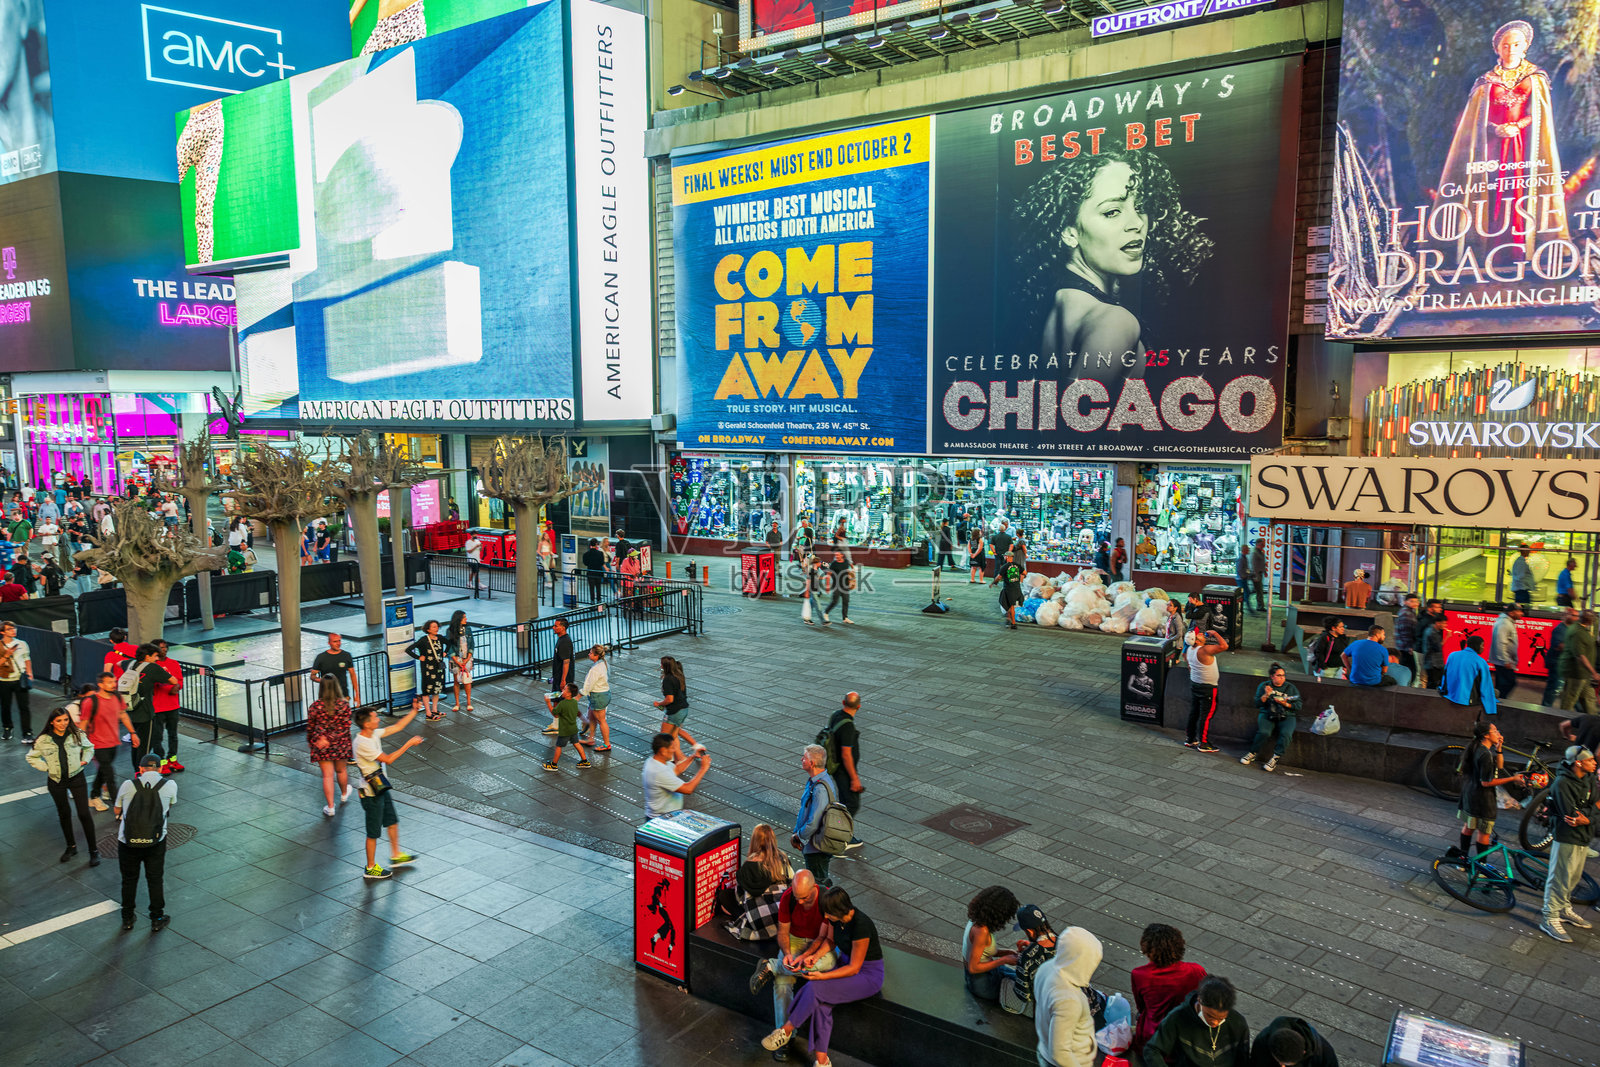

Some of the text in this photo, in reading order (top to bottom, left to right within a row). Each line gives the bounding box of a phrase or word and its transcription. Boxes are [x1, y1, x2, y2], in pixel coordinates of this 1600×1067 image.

[1096, 0, 1202, 34] OUTFRONT
[598, 24, 616, 176] OUTFITTERS
[989, 74, 1236, 134] BROADWAY'S
[1014, 112, 1202, 166] BEST BET
[684, 132, 912, 195] FINAL WEEKS! MUST END OCTOBER 2
[1466, 159, 1550, 174] HBO ORIGINAL
[1440, 181, 1486, 198] GAME
[1495, 170, 1570, 193] THRONES
[713, 186, 876, 227] WINNER! BEST MUSICAL
[1388, 192, 1566, 245] HOUSE
[601, 185, 618, 263] EAGLE
[714, 210, 875, 246] ALL ACROSS NORTH AMERICA
[713, 240, 873, 301] COME
[0, 278, 51, 300] EADER IN 5G
[132, 278, 178, 298] THE
[1336, 296, 1395, 314] NOW
[1402, 287, 1557, 312] STREAMING
[1569, 286, 1600, 303] HB
[603, 271, 621, 401] AMERICAN
[713, 348, 874, 400] AWAY
[945, 345, 1280, 372] CELEBRATING 25 YEARS
[302, 398, 573, 420] AMERICAN EAGLE OUTFITTERS
[727, 404, 858, 413] TRUE STORY. HIT MUSICAL.
[942, 374, 1277, 433] CHICAGO
[698, 435, 895, 447] ON BROADWAY COMEFROMAWAY.COM
[786, 422, 814, 430] Theatre,
[1409, 421, 1600, 448] SWAROVSK
[1153, 445, 1272, 454] CHICAGOTHEMUSICAL.COM
[974, 468, 1062, 494] SLAM
[1257, 464, 1600, 520] SWAROVS
[1125, 704, 1156, 714] CHICAGO
